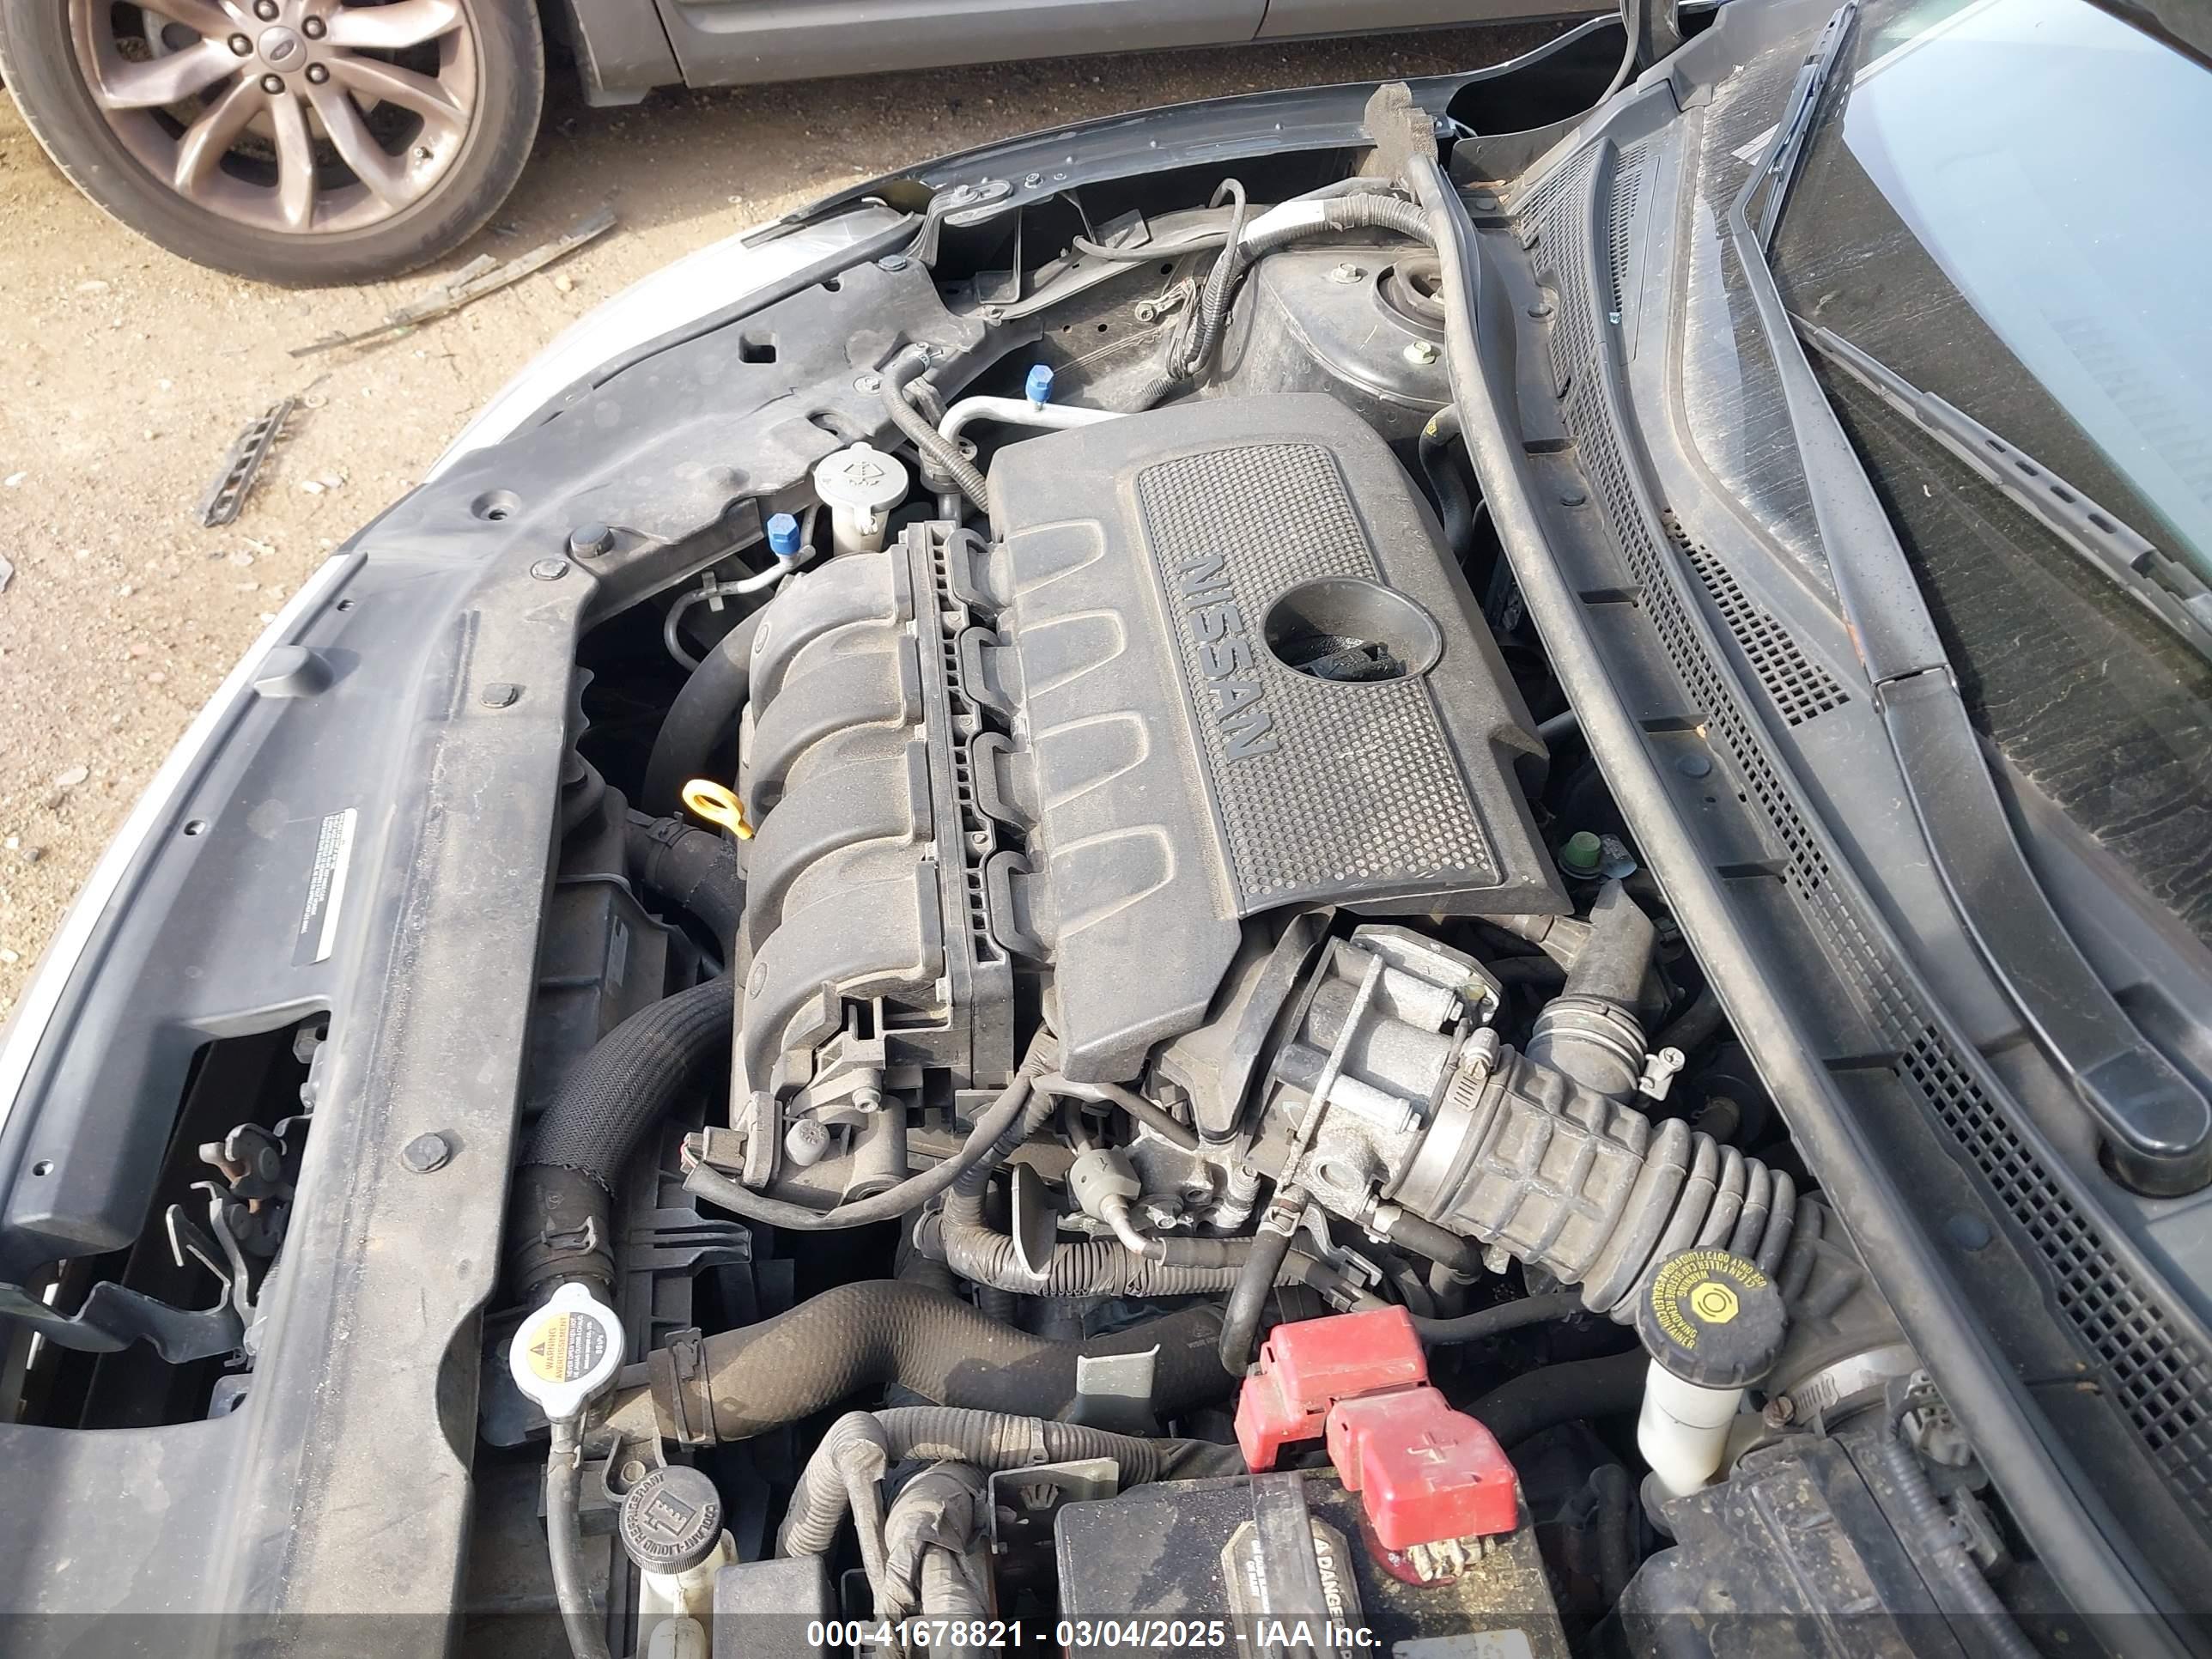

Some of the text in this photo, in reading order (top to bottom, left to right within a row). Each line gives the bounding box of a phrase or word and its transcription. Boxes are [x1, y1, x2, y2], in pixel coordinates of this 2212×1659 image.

[1176, 553, 1282, 765] NISSAN
[1678, 1250, 1704, 1264] FLUID
[1705, 1251, 1730, 1262] DOT3
[1731, 1256, 1754, 1274] ONLY
[1652, 1279, 1665, 1310] SEALED
[1676, 1269, 1708, 1297] WARNING
[1750, 1271, 1767, 1287] USE
[1665, 1260, 1755, 1339] CLEAN FILLER CAP BEFORE REMOVING
[1655, 1310, 1696, 1349] CONTAINER
[546, 1328, 556, 1370] WARNING
[556, 1317, 567, 1378] AVERTISSEMENT
[627, 1473, 716, 1556] COOLANT-LIQUID REFRIGERANT
